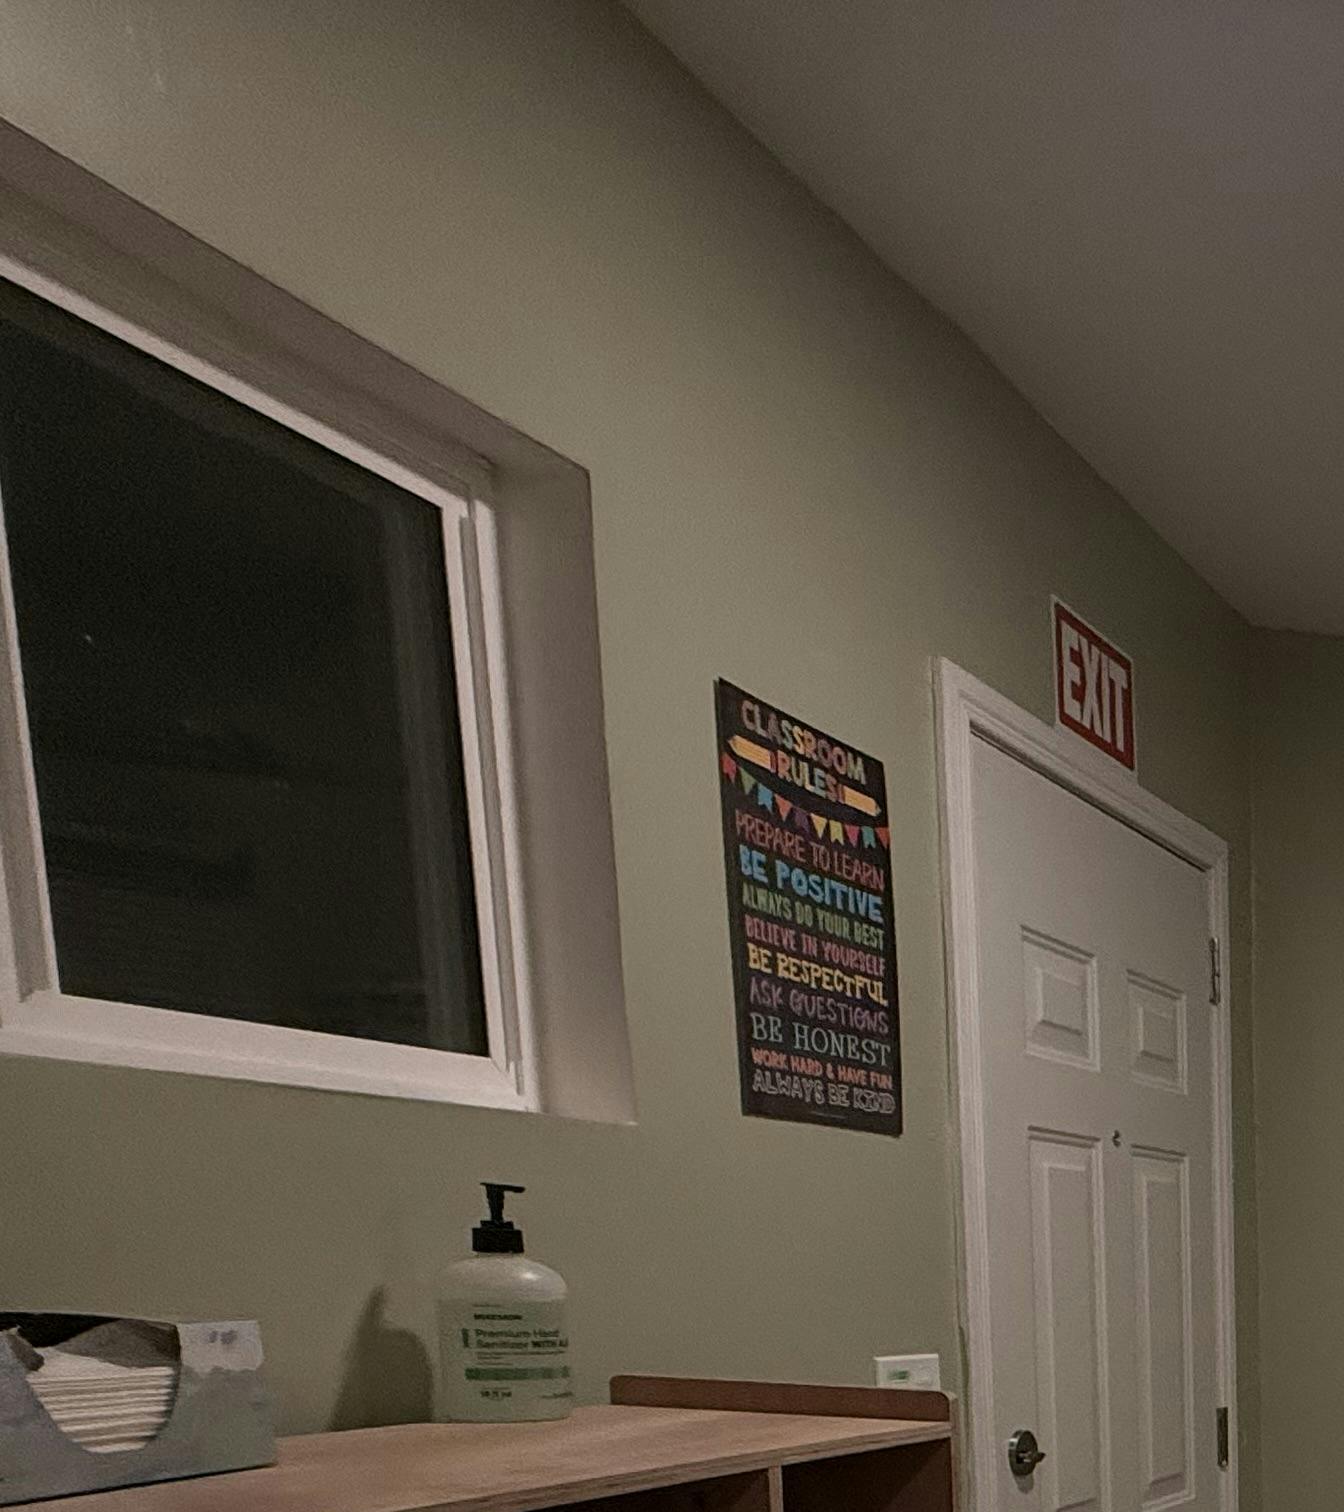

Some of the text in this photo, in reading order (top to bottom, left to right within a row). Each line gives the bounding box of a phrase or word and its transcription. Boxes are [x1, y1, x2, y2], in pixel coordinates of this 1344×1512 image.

[1061, 619, 1128, 754] EXIT
[741, 700, 867, 785] CLASSROOM
[735, 808, 885, 892] PREPARE TO LEARN
[739, 844, 884, 924] BE POSITIVE
[742, 882, 885, 951] ALWAYS DO YOUR BEST
[745, 914, 885, 977] BELIEVE IN YOURSELF
[747, 942, 888, 1008] BE RESPECTFUL
[750, 977, 889, 1034] ASK QUESTIONS
[751, 1012, 892, 1067] BE HONEST
[752, 1048, 789, 1070] WORK
[790, 1055, 823, 1077] HARD
[837, 1064, 867, 1086] HAVE
[870, 1071, 893, 1090] FUN
[752, 1068, 897, 1114] ALWAYS BE KIND
[475, 1328, 531, 1338] Premium
